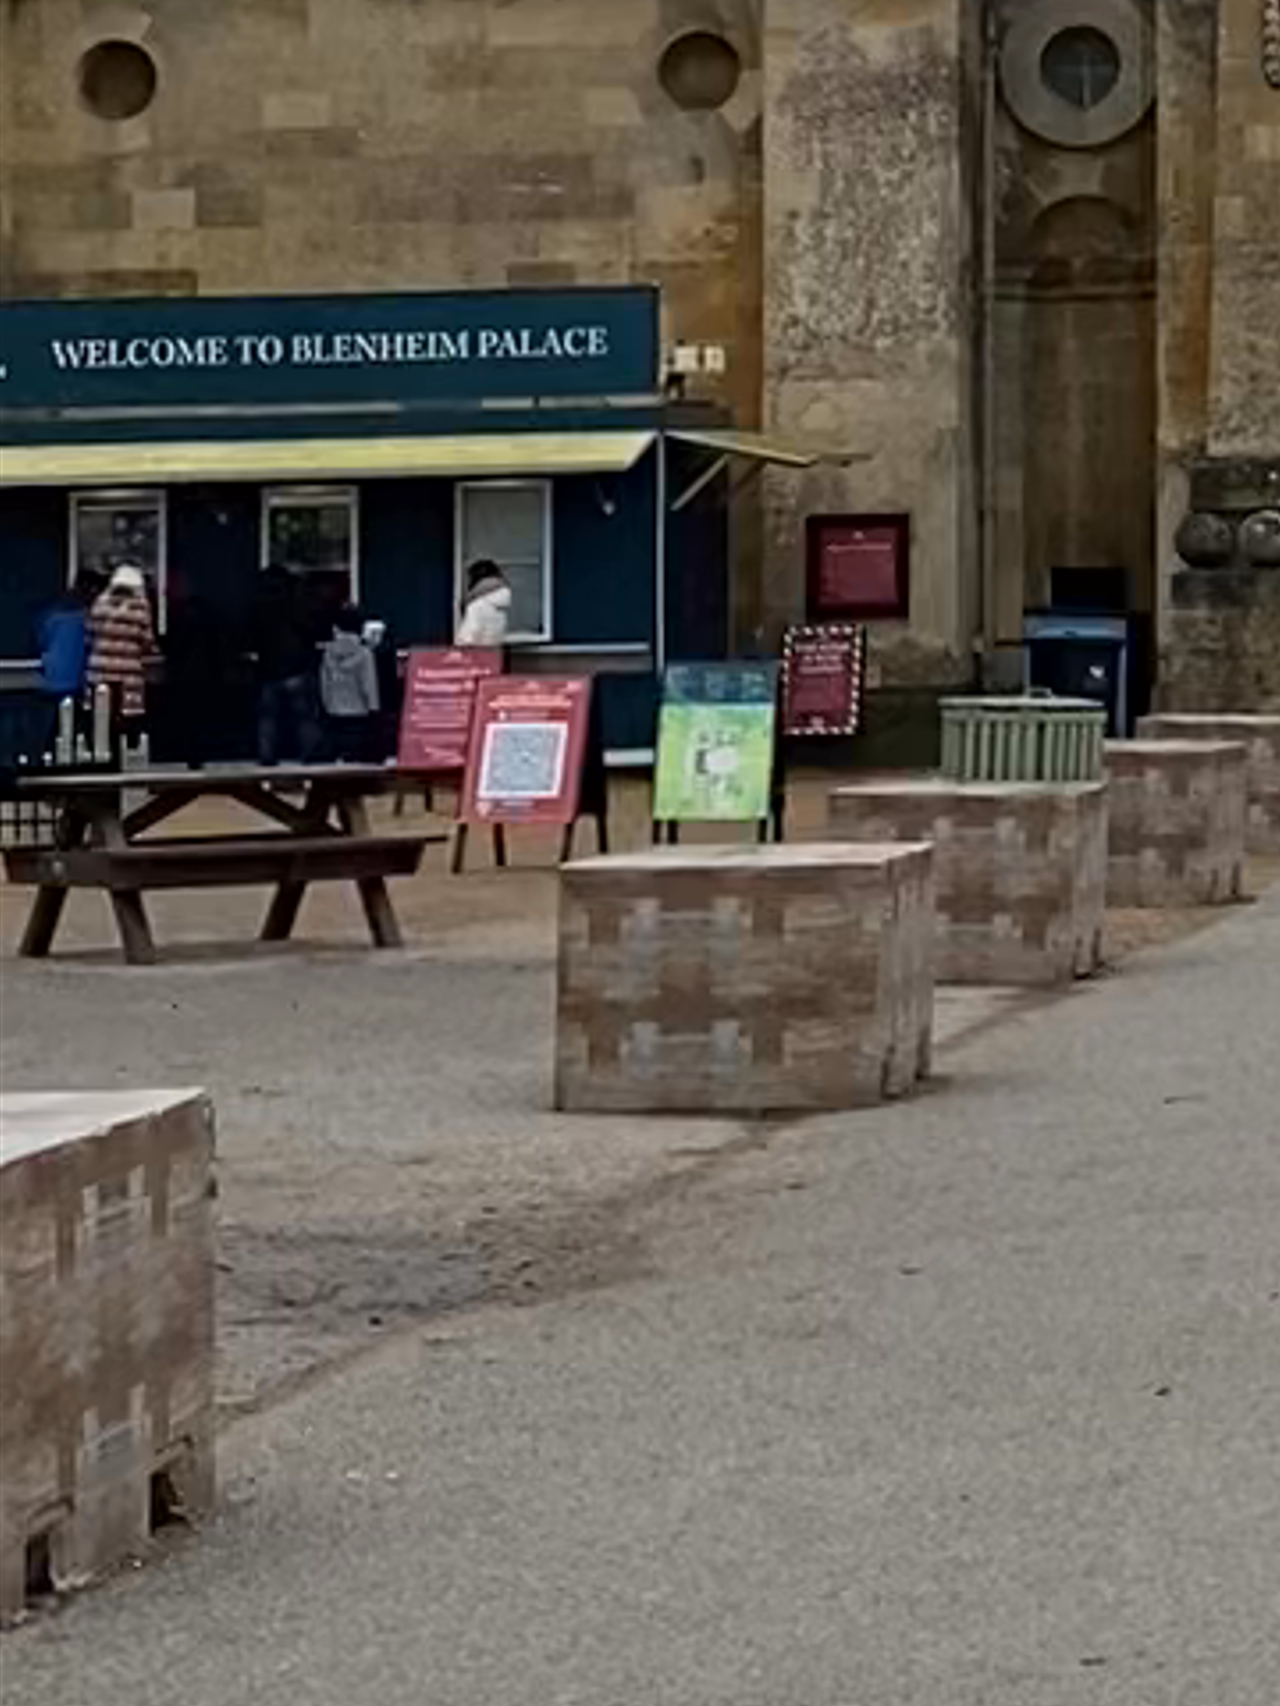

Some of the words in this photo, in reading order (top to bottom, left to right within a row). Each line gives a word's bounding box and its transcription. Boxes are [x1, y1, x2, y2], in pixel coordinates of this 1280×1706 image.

[52, 337, 229, 368] WELCOME
[234, 335, 284, 366] TO
[292, 329, 470, 364] BLENHEIM
[478, 327, 609, 358] PALACE
